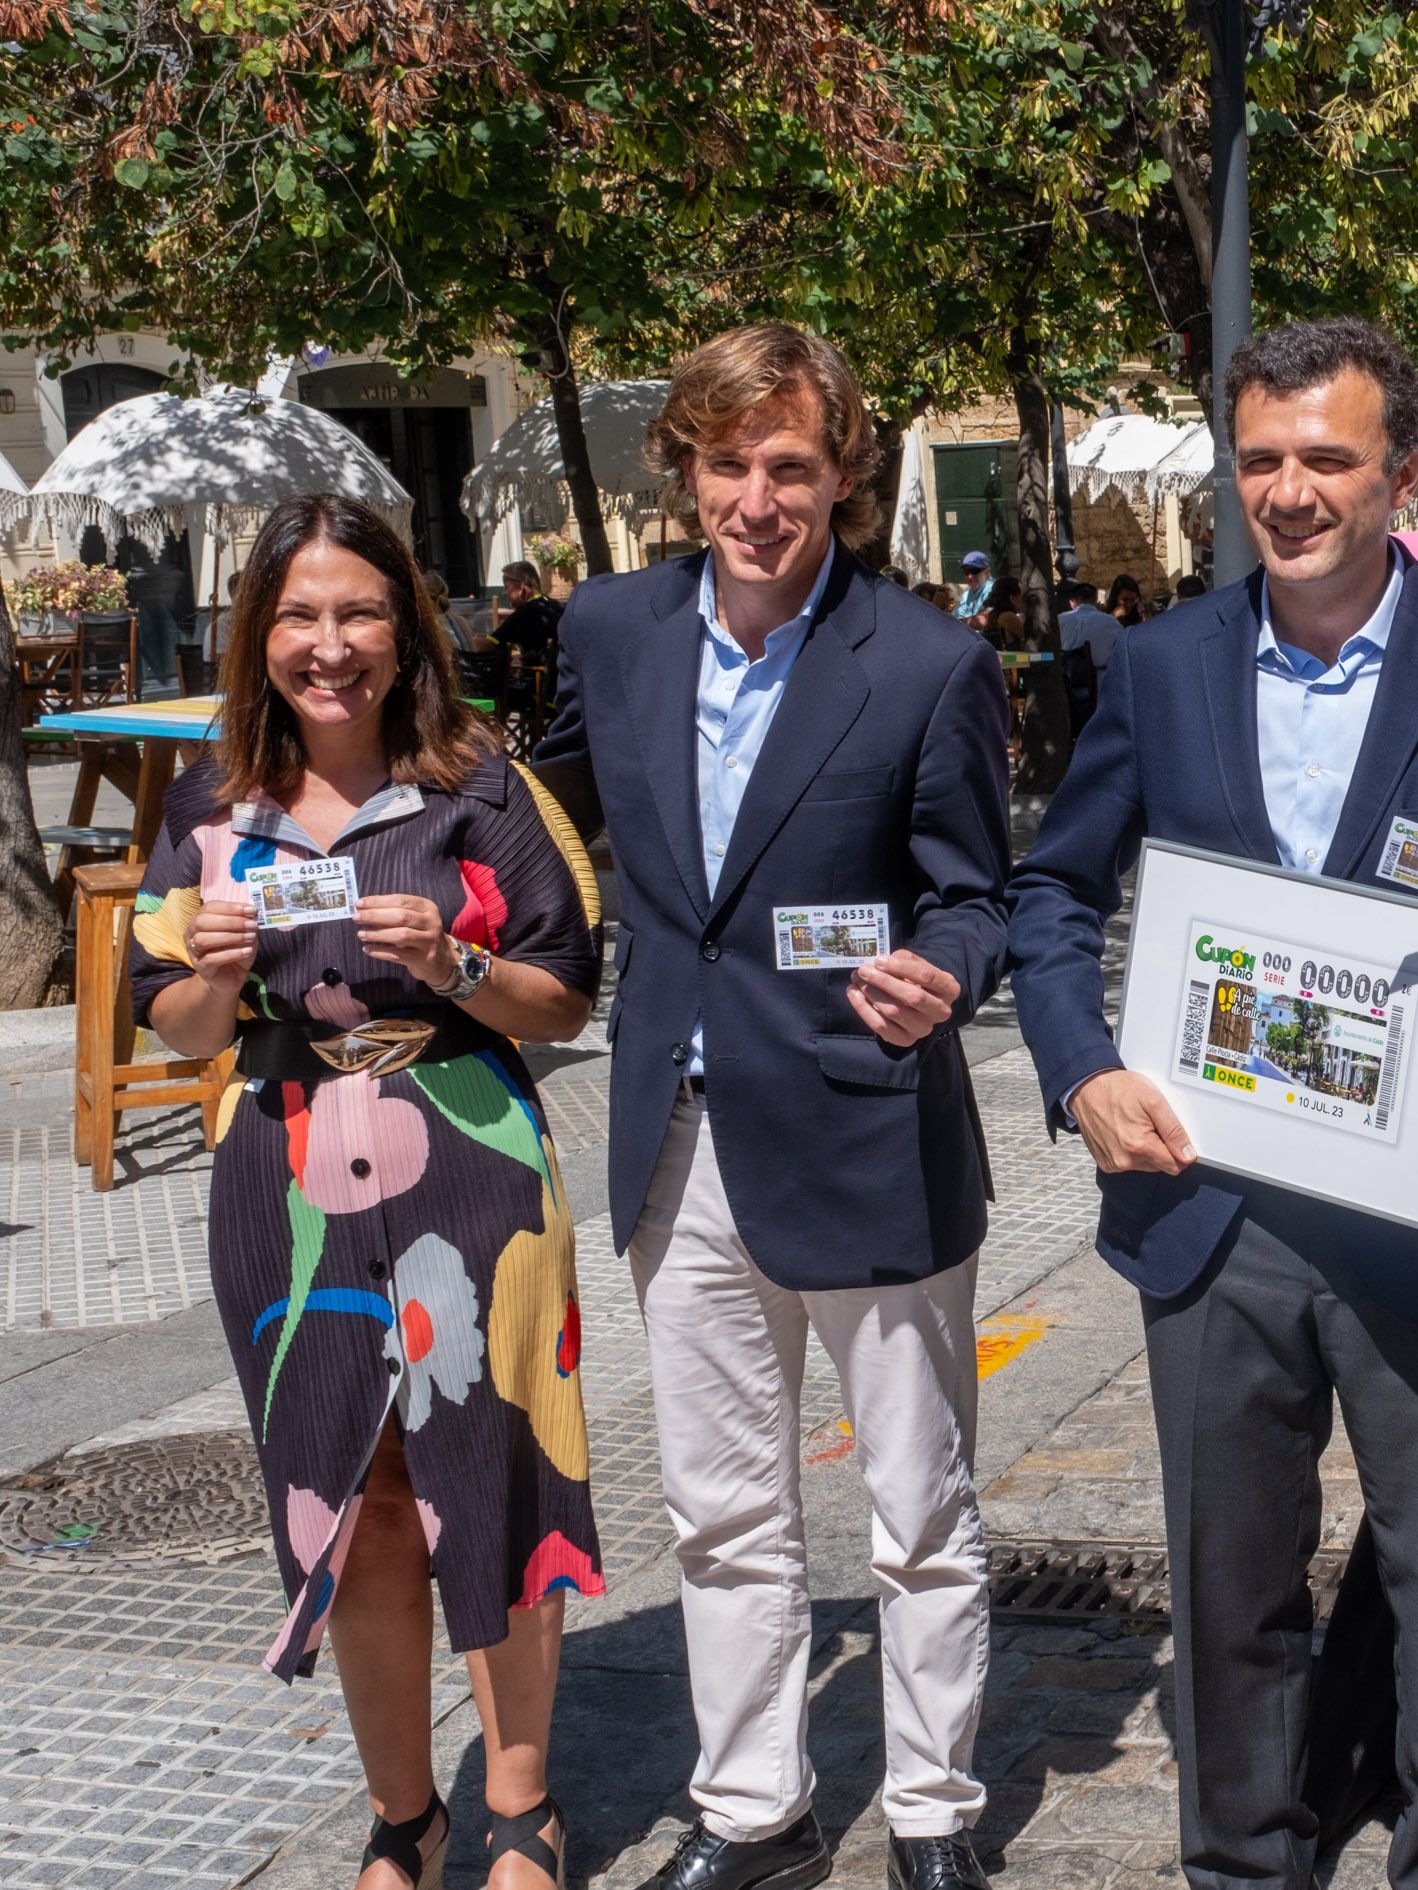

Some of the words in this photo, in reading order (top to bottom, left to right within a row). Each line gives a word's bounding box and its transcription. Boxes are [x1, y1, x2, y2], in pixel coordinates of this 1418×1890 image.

[120, 338, 134, 354] 27
[361, 381, 430, 400] ANTÍPDA
[300, 862, 340, 876] 46538
[832, 909, 874, 920] 46538
[1263, 952, 1291, 972] 000
[1300, 960, 1390, 1008] 00000
[1264, 972, 1285, 985] SERIE
[1233, 988, 1241, 1003] A
[1241, 992, 1256, 1008] pie
[1401, 984, 1412, 996] 2€
[1231, 1002, 1241, 1015] de
[1242, 1007, 1262, 1021] calle
[1218, 1070, 1253, 1089] ONCE
[1299, 1096, 1310, 1108] 10
[1310, 1100, 1330, 1114] JUL.
[1332, 1105, 1344, 1118] 23
